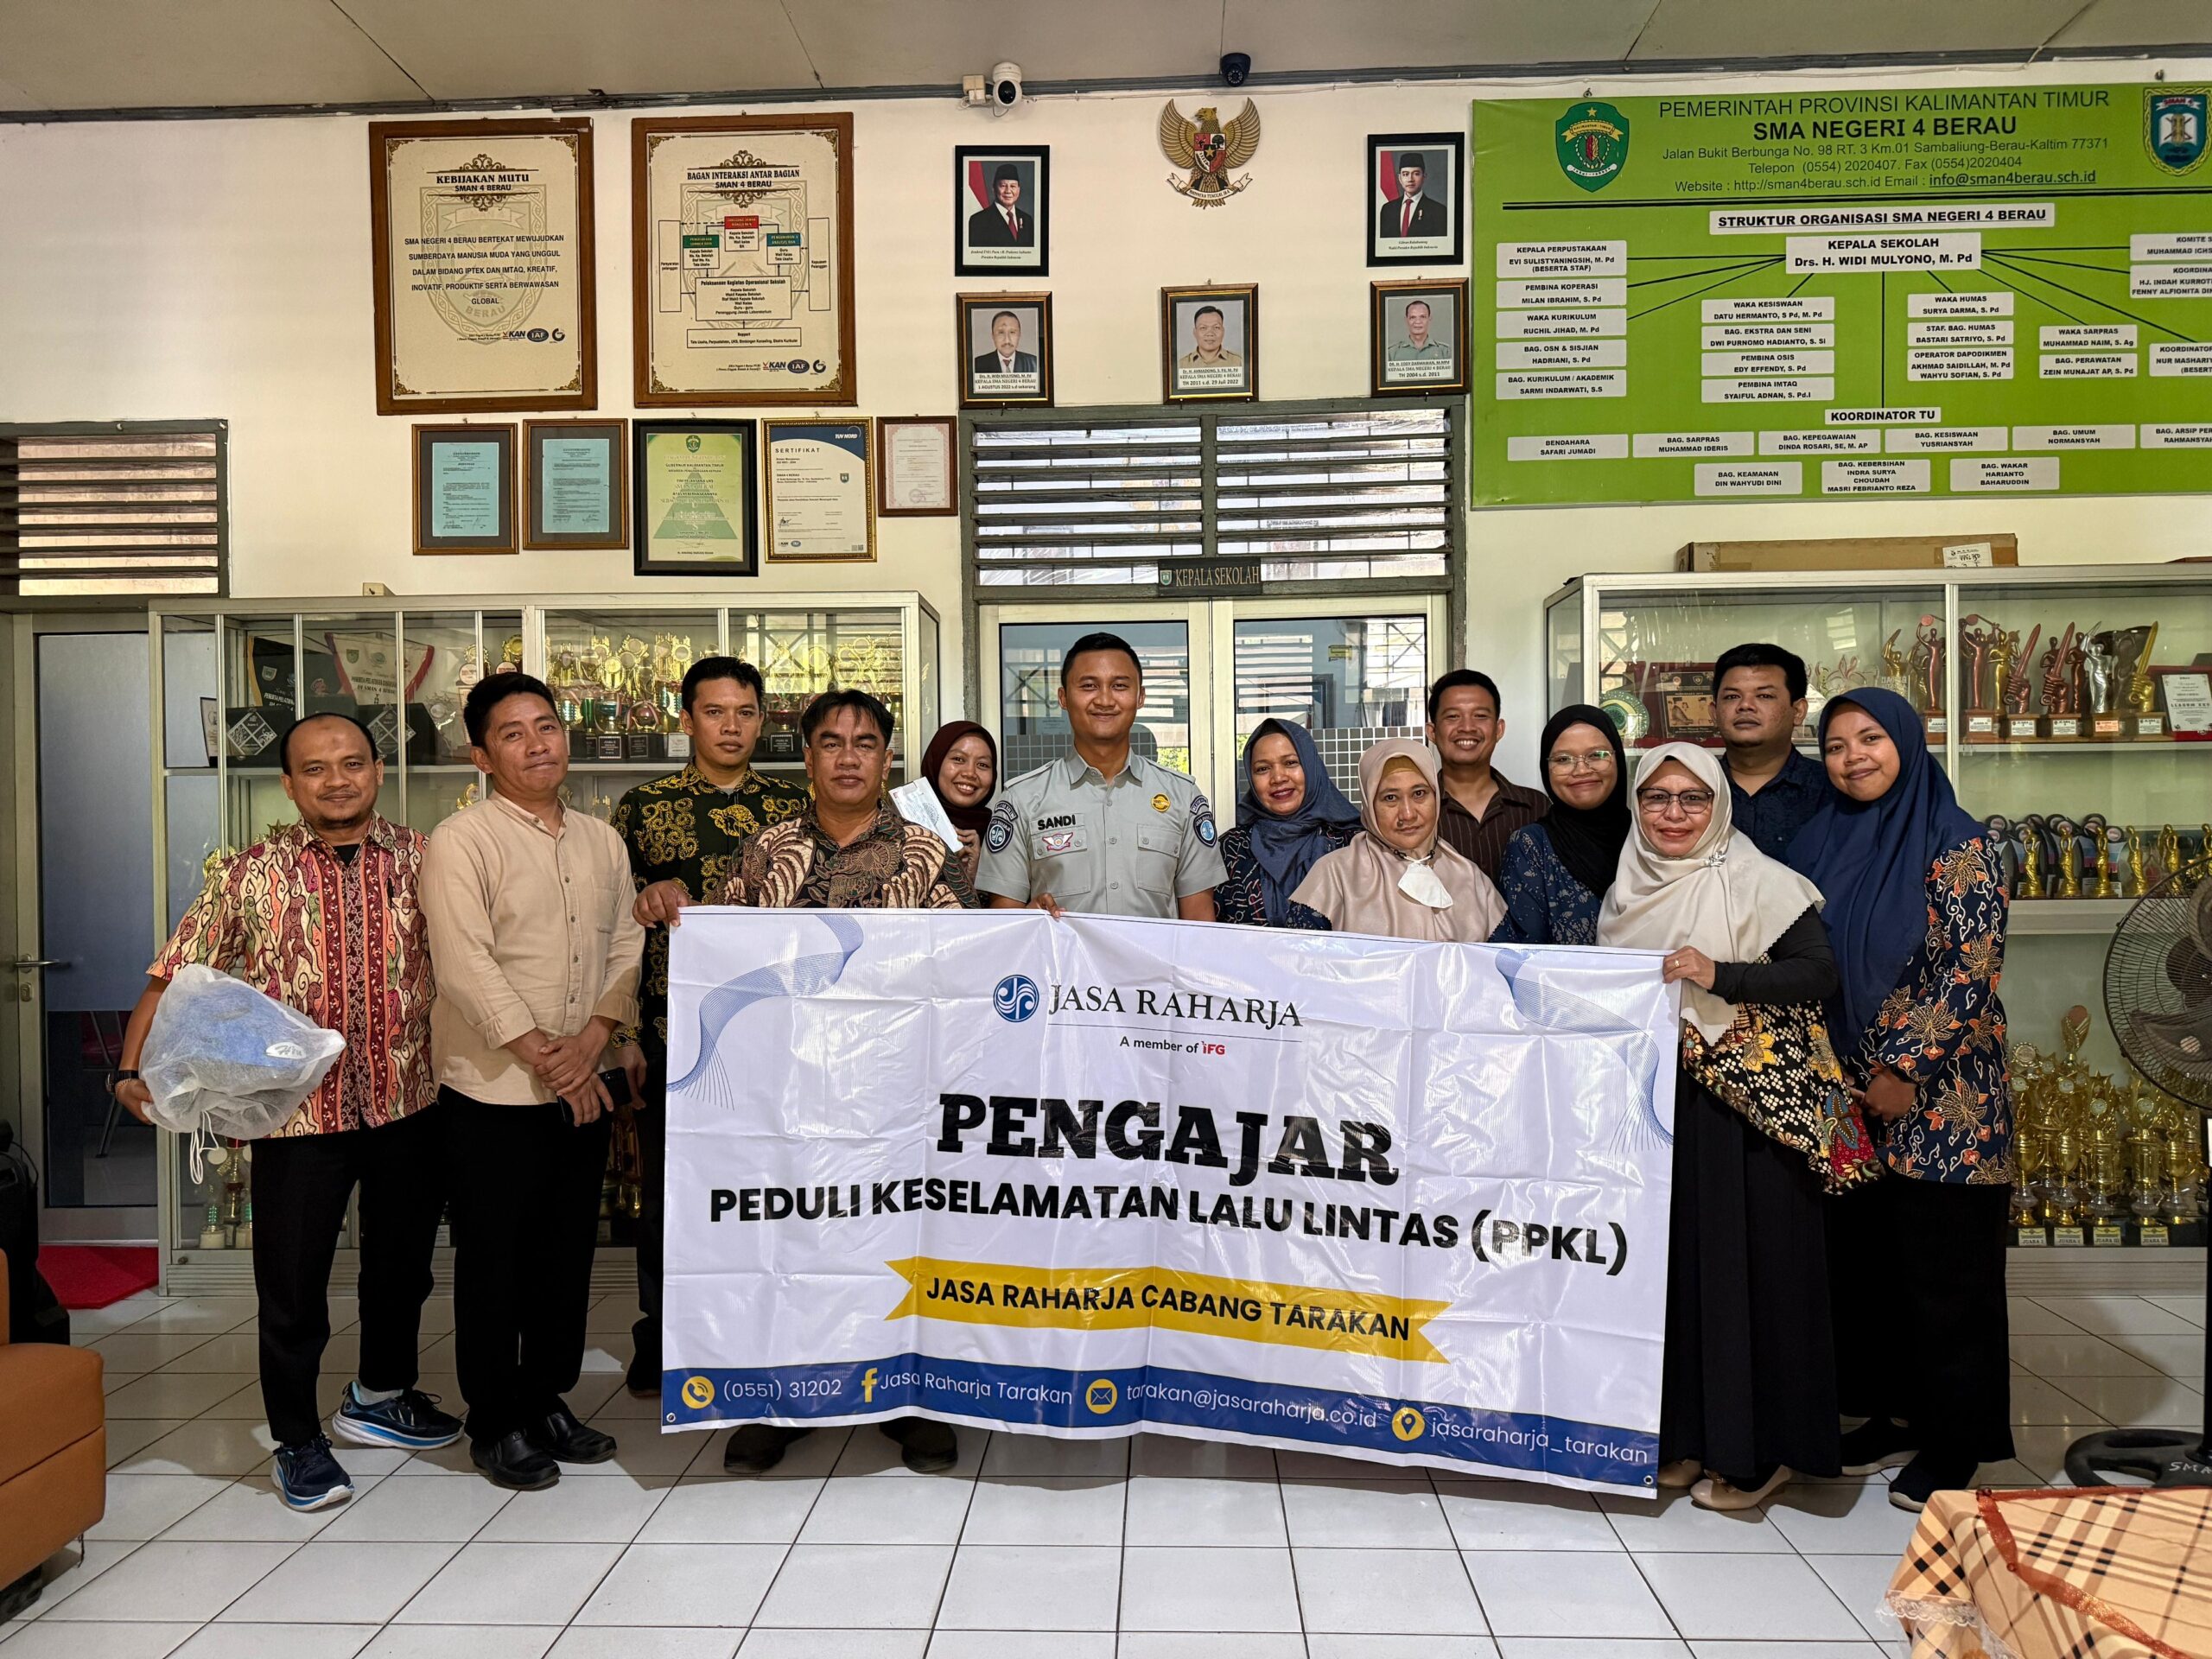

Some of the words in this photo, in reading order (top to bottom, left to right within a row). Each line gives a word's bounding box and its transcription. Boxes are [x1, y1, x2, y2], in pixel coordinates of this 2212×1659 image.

[1659, 98, 1792, 118] PEMERINTAH
[1799, 95, 1898, 114] PROVINSI
[1904, 91, 2037, 111] KALIMANTAN
[2042, 89, 2110, 108] TIMUR
[1752, 121, 1806, 141] SMA
[1811, 118, 1906, 139] NEGERI
[1911, 118, 1926, 137] 4
[1932, 115, 2017, 136] BERAU
[1662, 148, 1694, 160] Jalan
[1697, 147, 1728, 158] Bukit
[1731, 145, 1789, 160] Berbunga
[1792, 144, 1814, 156] No.
[1816, 143, 1833, 156] 98
[1836, 143, 1856, 155] RT.
[1859, 143, 1867, 155] 3
[1871, 142, 1909, 154] Km.01
[1913, 137, 2069, 155] Sambaliung-Berau-Kaltim
[2070, 137, 2107, 149] 77371
[686, 171, 710, 180] BAGAN
[711, 170, 748, 180] INTERAKSI
[749, 169, 772, 178] ANTAR
[773, 168, 800, 178] BAGIAN
[1747, 162, 1795, 175] Telepon
[1802, 160, 1841, 175] (0554)
[1844, 159, 1901, 171] 2020407.
[1904, 158, 1928, 169] Fax
[1929, 155, 2024, 172] (0554)2020404
[435, 174, 495, 184] KEBIJAKAN
[498, 173, 529, 182] MUTU
[1675, 180, 1723, 192] Website
[1733, 175, 1881, 193] http://sman4berau.sch.id
[1884, 175, 1918, 187] Email
[1929, 168, 2097, 187] info@sman4berau.sch.id
[1718, 214, 1796, 226] STRUKTUR
[1799, 213, 1887, 224] ORGANISASI
[1891, 212, 1923, 222] SMA
[1927, 210, 1980, 221] NEGERI
[1984, 209, 1994, 220] 4
[1998, 208, 2046, 220] BERAU
[477, 235, 514, 244] BERTEKAT
[1827, 239, 1877, 250] KEPALA
[1879, 237, 1939, 249] SEKOLAH
[408, 252, 456, 261] SUMBERDAYA
[1794, 257, 1819, 266] Drs.
[1821, 256, 1835, 266] H.
[1838, 256, 1866, 265] WIDI
[1870, 254, 1936, 265] MULYONO,
[1939, 253, 1953, 263] M.
[1956, 253, 1972, 263] Pd
[464, 266, 485, 275] IPTEK
[1531, 264, 1568, 273] (BESERTA
[445, 282, 484, 290] PRODUKTIF
[508, 280, 559, 289] BERWAWASAN
[1830, 410, 1916, 421] KOORDINATOR
[1918, 410, 1936, 419] TU
[1175, 567, 1214, 588] KEPALA
[1213, 565, 1261, 587] SEKOLAH
[1037, 813, 1077, 831] SANDI
[1047, 983, 1127, 1016] JASA
[1135, 988, 1305, 1031] RAHARJA
[1119, 1036, 1130, 1047] A
[1132, 1038, 1184, 1052] member
[1185, 1041, 1200, 1054] of
[937, 1093, 1400, 1186] PENGAJAR
[709, 1184, 862, 1223] PEDULI
[871, 1176, 1180, 1222] KESELAMATAN
[1187, 1189, 1293, 1233] LALU
[1302, 1201, 1460, 1249] LINTAS
[1471, 1209, 1628, 1277] (PPKL)
[925, 1276, 996, 1306] JASA
[1001, 1283, 1134, 1312] RAHARJA
[1141, 1283, 1262, 1322] CABANG
[1268, 1301, 1410, 1342] TARAKAN
[722, 1378, 783, 1402] (0551)
[788, 1378, 843, 1399] 31202
[878, 1371, 921, 1390] Jasa
[924, 1372, 992, 1401] Raharja
[995, 1382, 1073, 1406] Tarakan
[1125, 1382, 1377, 1429] tarakan@jasaraharja.co.id
[1429, 1417, 1649, 1465] jasaraharja_tarakan
